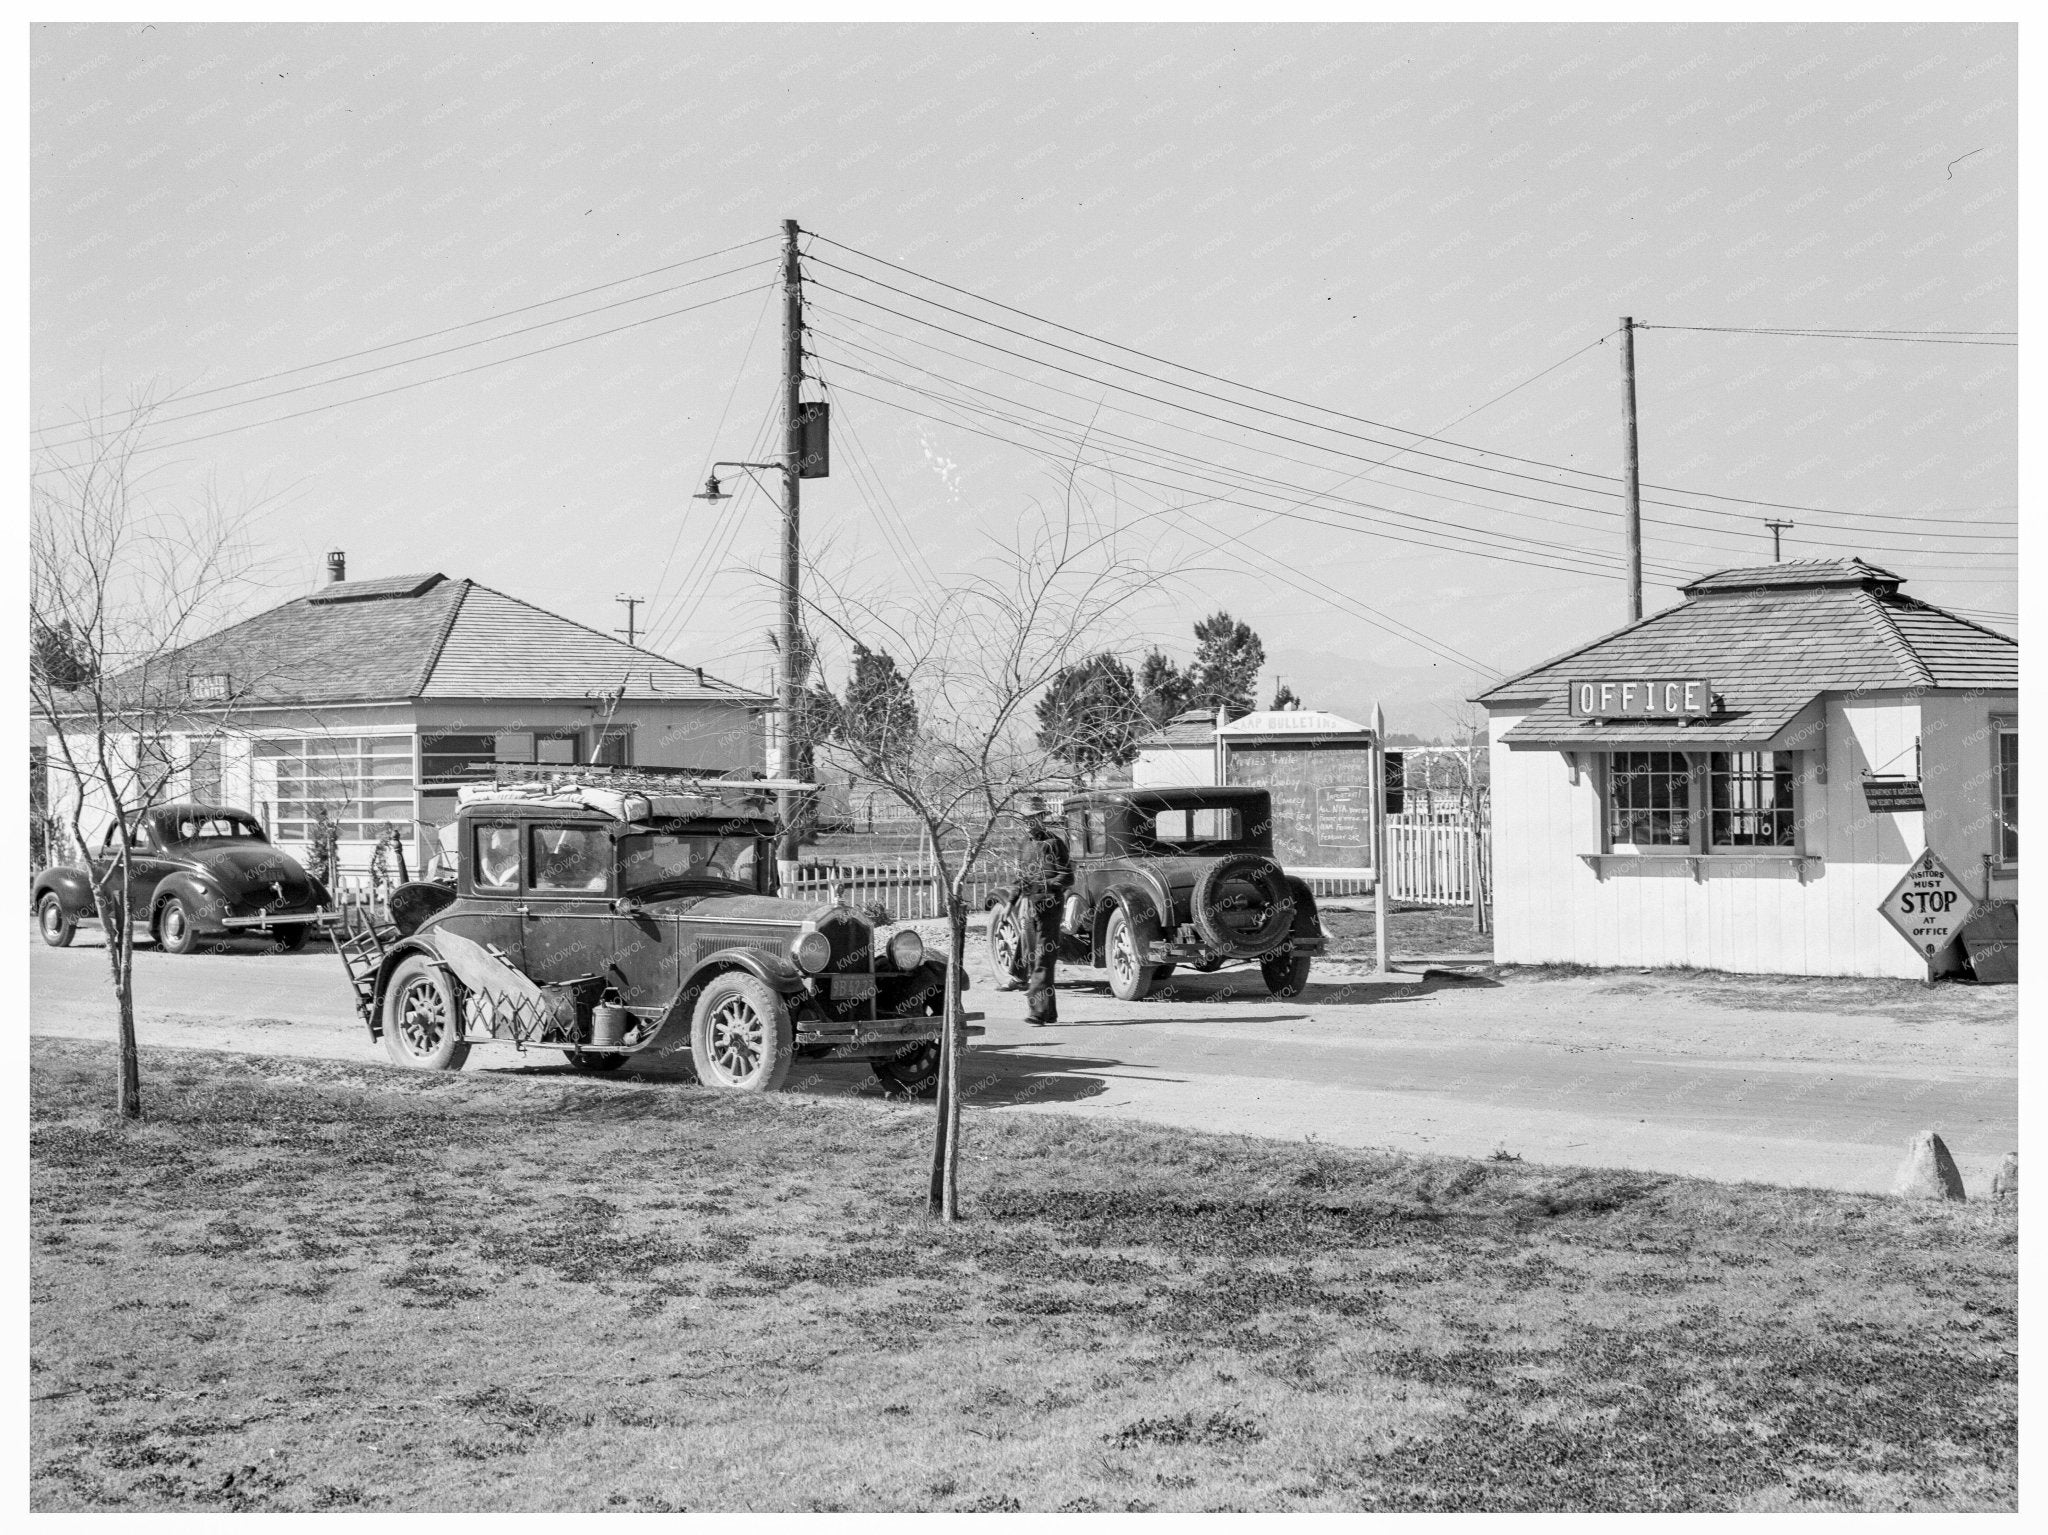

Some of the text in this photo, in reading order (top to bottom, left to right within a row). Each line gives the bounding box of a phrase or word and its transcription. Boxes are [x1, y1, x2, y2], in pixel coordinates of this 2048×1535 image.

[1580, 682, 1701, 713] OFFICE
[1910, 870, 1945, 880] VISITORS
[1914, 880, 1941, 888] MUST
[1901, 891, 1958, 913] STOP
